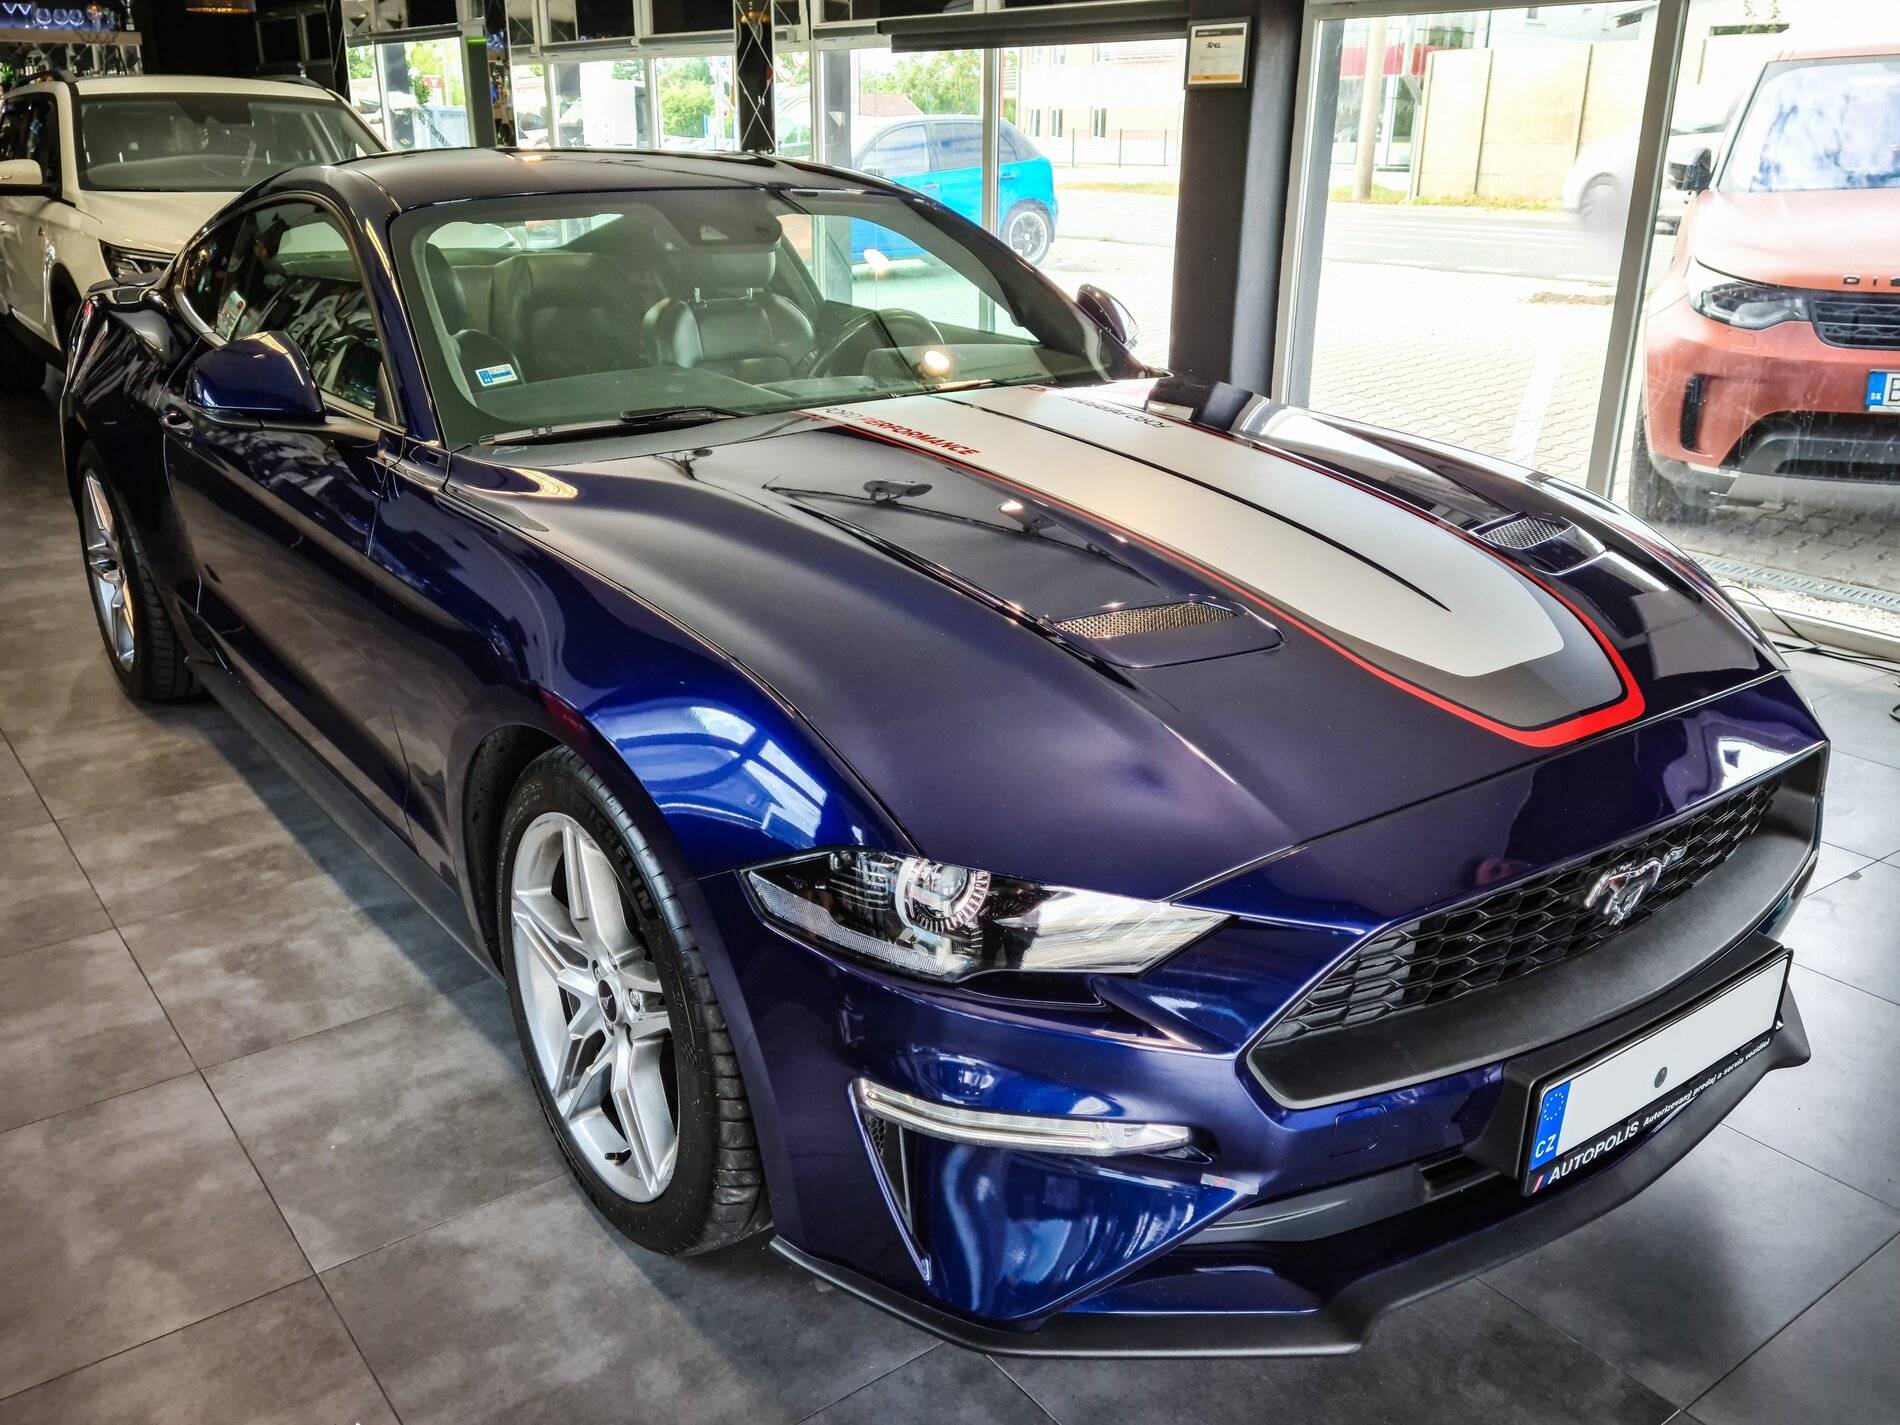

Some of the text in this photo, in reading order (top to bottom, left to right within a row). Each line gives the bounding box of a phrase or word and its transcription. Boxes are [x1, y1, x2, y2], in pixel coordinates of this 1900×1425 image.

[853, 416, 980, 455] PERFORMANCE
[568, 792, 654, 911] ICHELIN
[1535, 1133, 1557, 1159] CZ
[1548, 1121, 1640, 1184] AUTOPOLIS
[1723, 1057, 1745, 1075] servis
